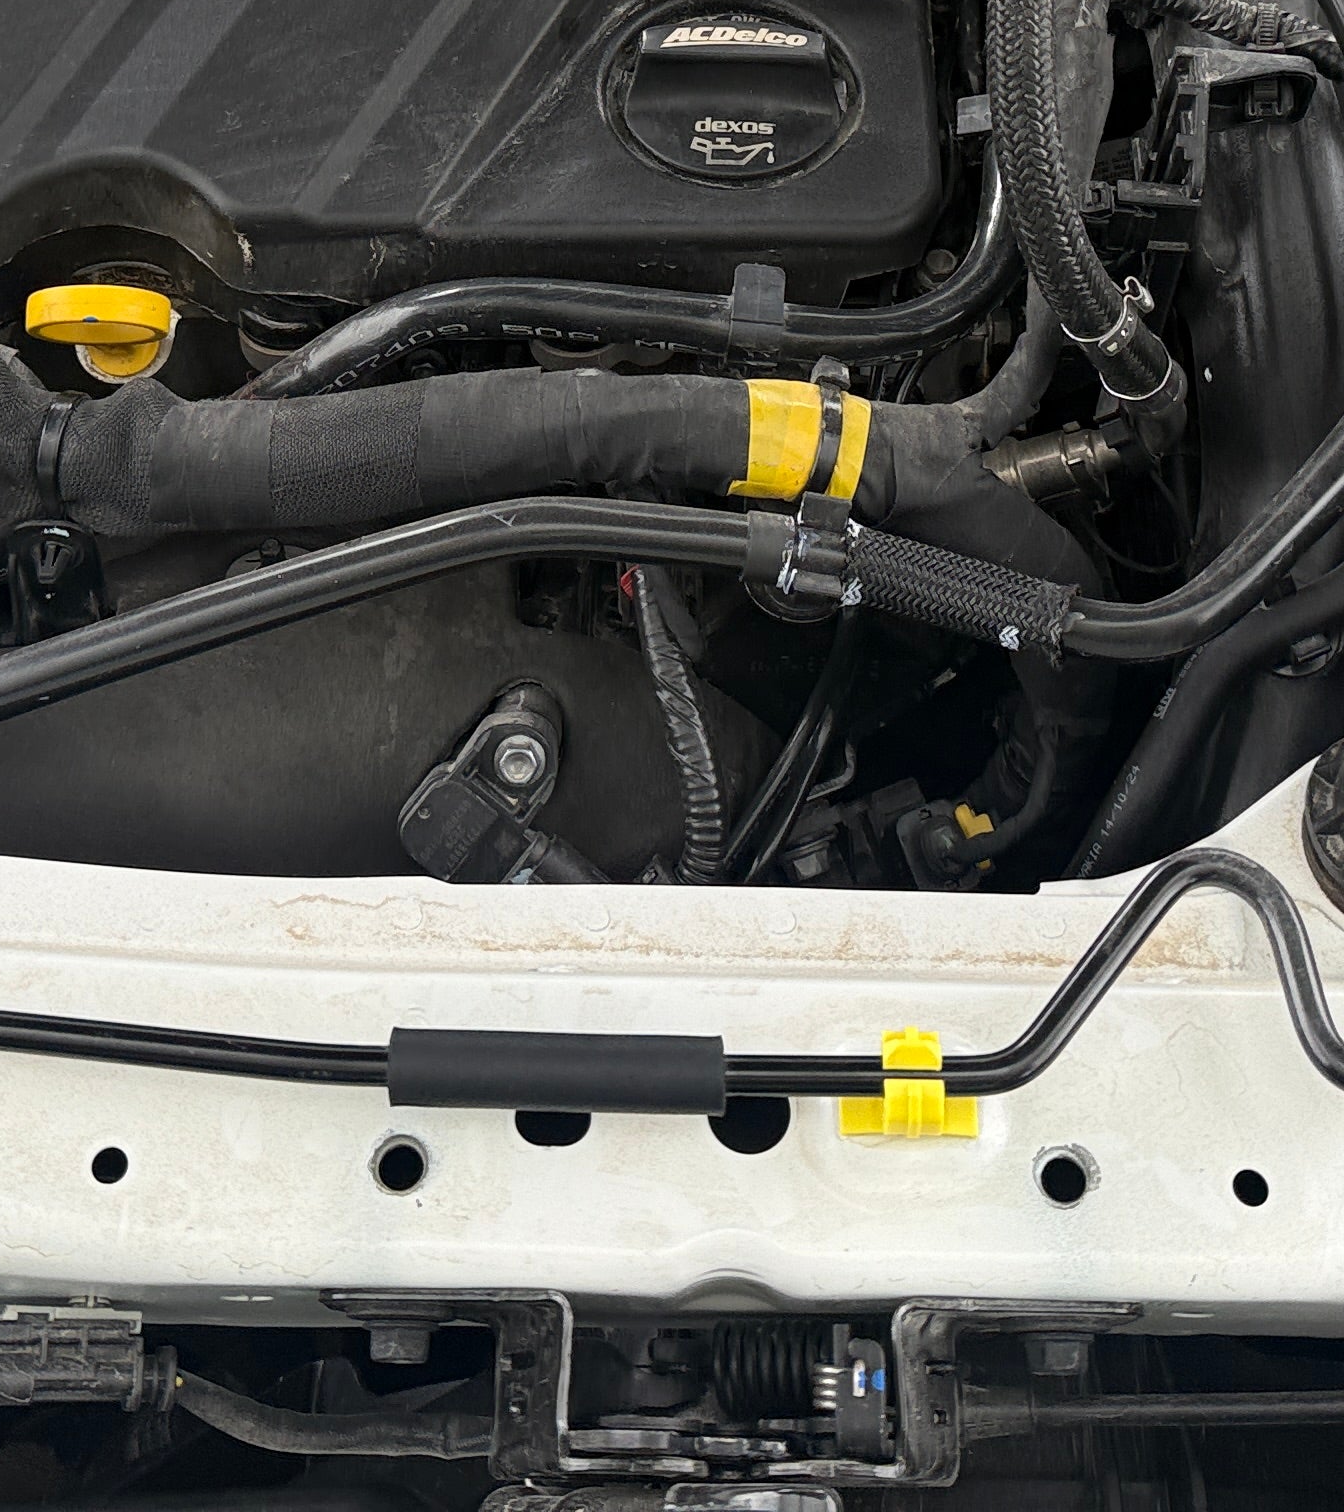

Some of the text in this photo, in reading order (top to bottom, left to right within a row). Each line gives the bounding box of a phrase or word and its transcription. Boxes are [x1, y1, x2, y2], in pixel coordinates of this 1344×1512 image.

[661, 26, 808, 48] ACDelco
[694, 116, 776, 135] dexos
[1100, 763, 1141, 837] 14/10/24
